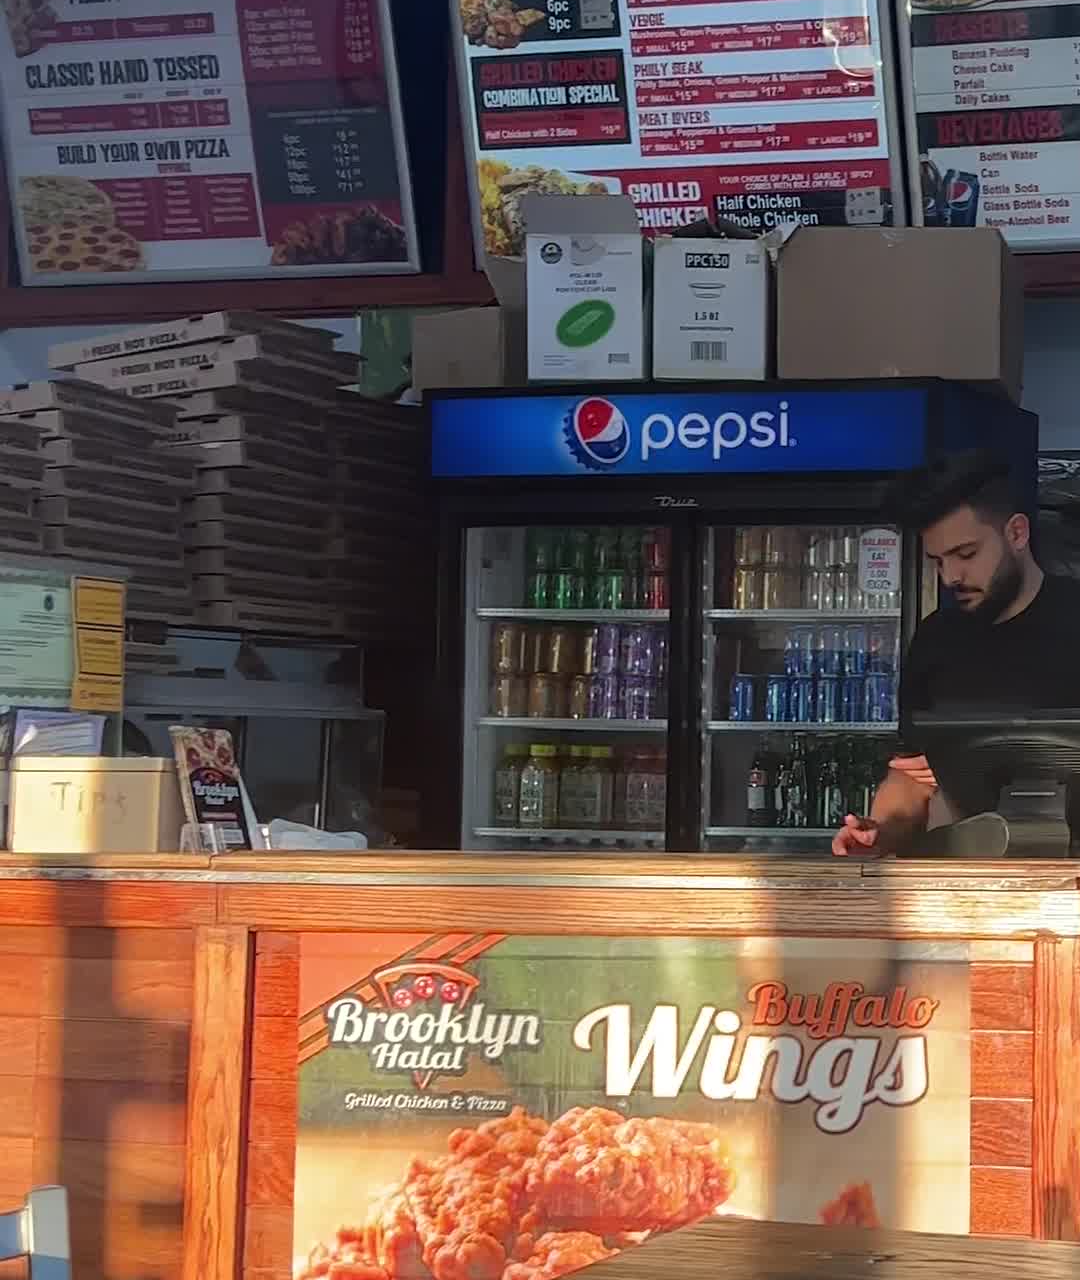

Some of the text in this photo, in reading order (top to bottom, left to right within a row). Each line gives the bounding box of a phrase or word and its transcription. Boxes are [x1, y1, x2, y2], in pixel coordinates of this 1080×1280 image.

[548, 17, 571, 32] 9pc
[25, 54, 220, 89] CLASSIC HAND TOSSED
[483, 84, 620, 108] COMBINATION SPECIAL
[639, 112, 668, 126] MEAT
[56, 138, 230, 164] BUILD YOUR OWN PIZZA
[628, 182, 701, 204] GRILLED
[717, 194, 801, 210] Half Chicken
[763, 211, 819, 227] Chicken
[686, 255, 729, 268] PPC150
[124, 337, 145, 350] HOT
[150, 332, 179, 346] PIZZA
[179, 353, 210, 367] PIZZA
[157, 378, 188, 392] PIZZA
[641, 401, 789, 461] pepsi
[748, 981, 940, 1039] Buffalo
[327, 998, 540, 1058] Brooklyn
[371, 1042, 465, 1070] Halal
[572, 1004, 929, 1134] Wings
[344, 1092, 507, 1111] Grilled Chicken & Pizza
